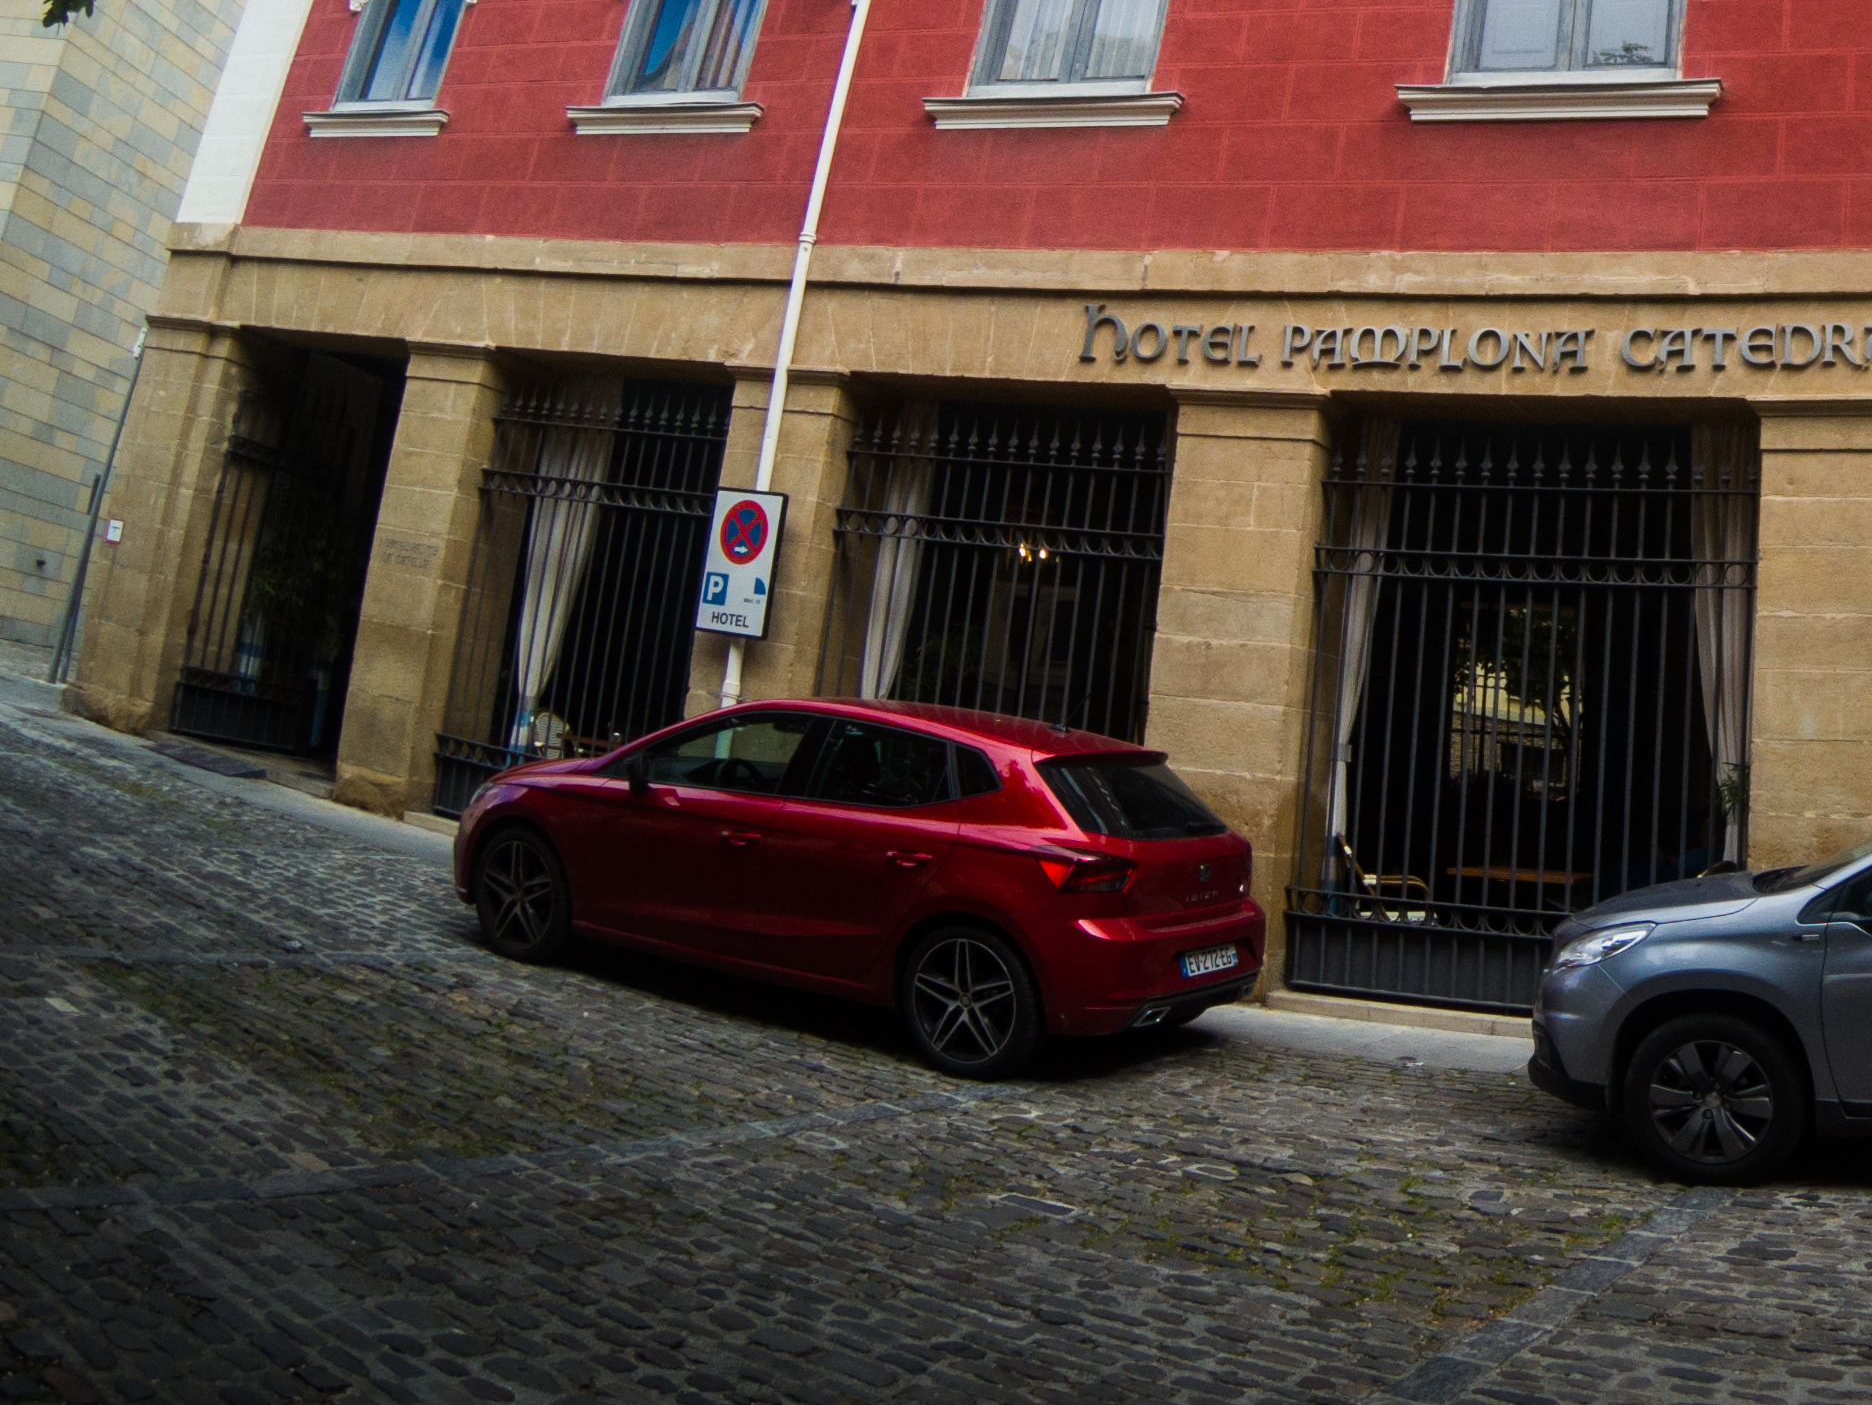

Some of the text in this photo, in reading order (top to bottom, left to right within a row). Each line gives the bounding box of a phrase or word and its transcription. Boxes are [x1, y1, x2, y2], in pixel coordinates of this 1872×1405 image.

[1280, 323, 1595, 373] PAMPLONA
[706, 575, 724, 601] P
[711, 611, 749, 628] HOTEL
